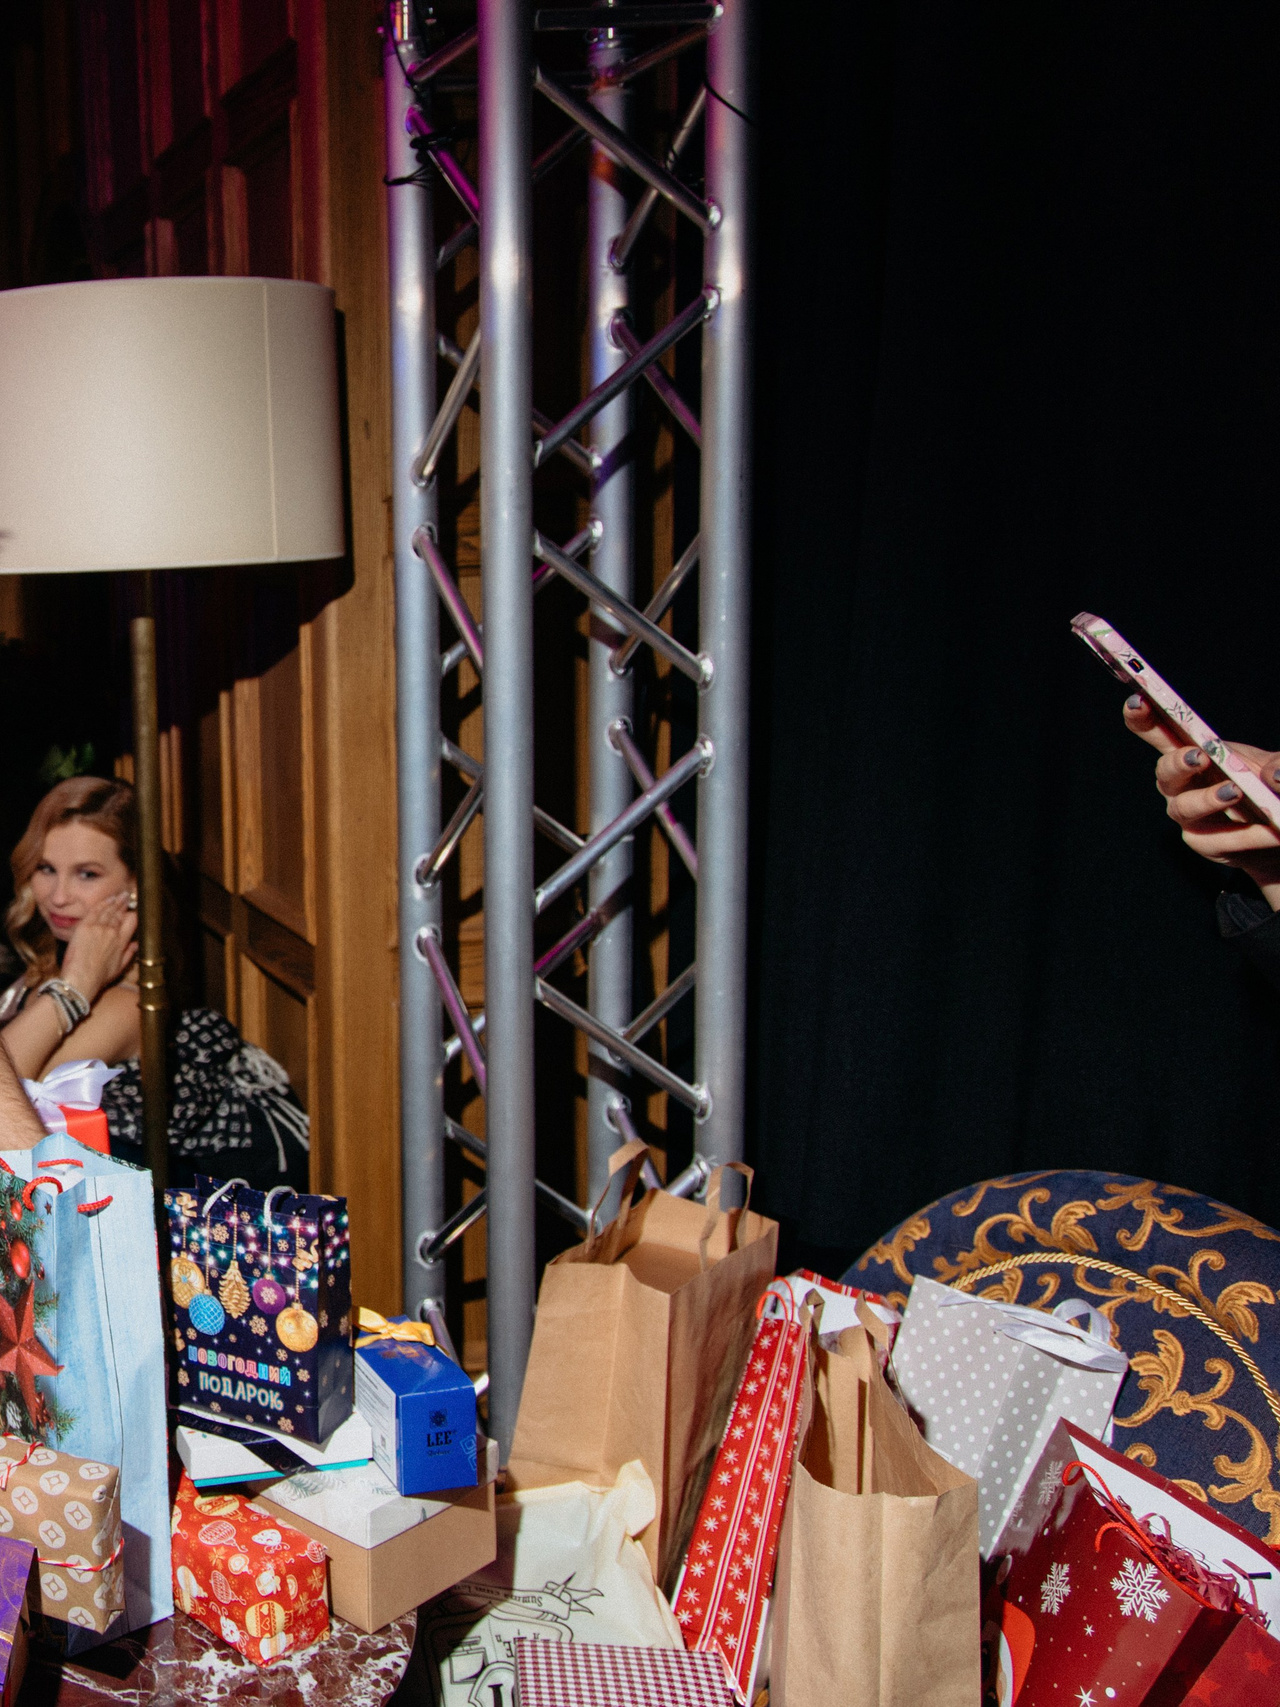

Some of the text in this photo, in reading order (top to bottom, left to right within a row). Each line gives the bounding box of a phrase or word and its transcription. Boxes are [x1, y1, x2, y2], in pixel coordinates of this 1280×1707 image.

[188, 1344, 291, 1386] НОВОГОДНИЙ
[199, 1371, 284, 1411] ПОДАРОК
[426, 1430, 453, 1448] LEE
